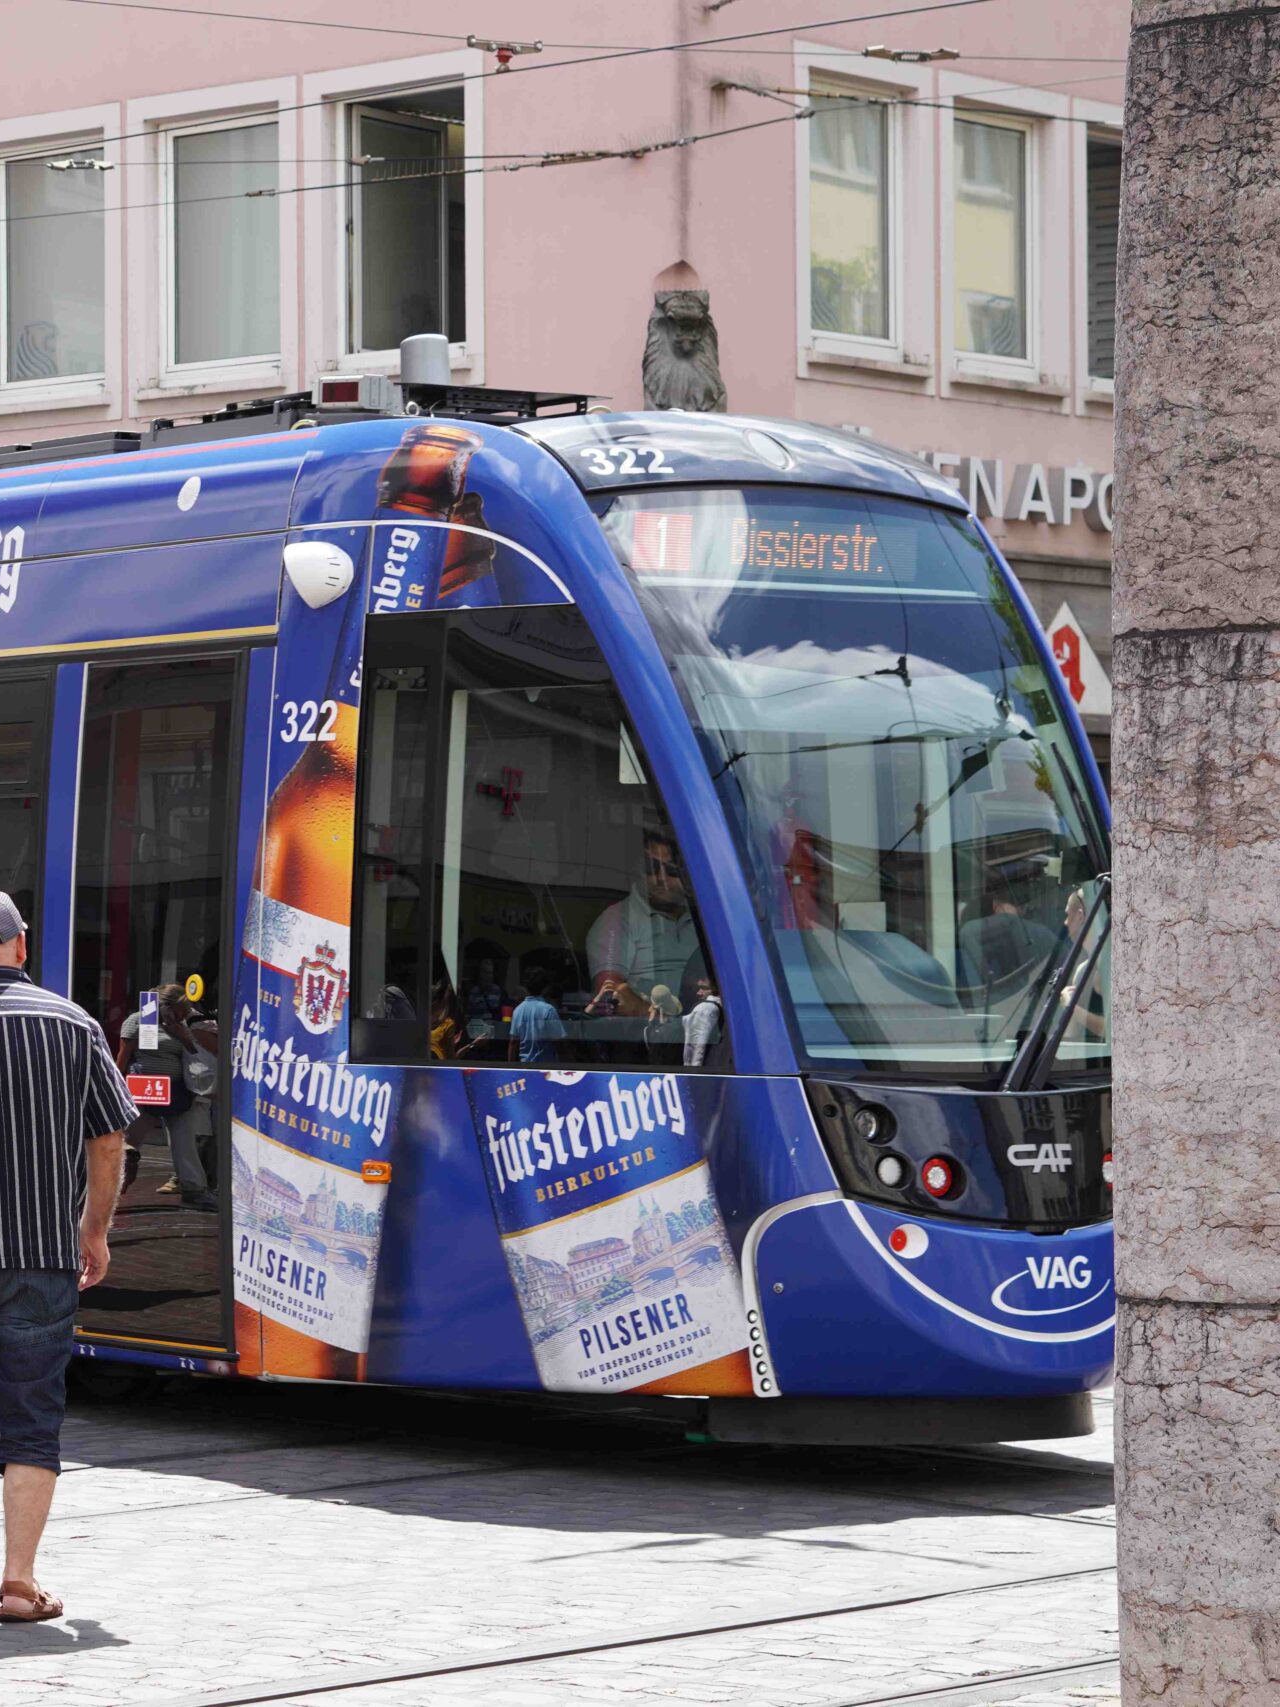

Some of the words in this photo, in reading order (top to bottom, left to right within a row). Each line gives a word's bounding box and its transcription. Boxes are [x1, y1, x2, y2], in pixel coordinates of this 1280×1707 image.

[580, 446, 674, 476] 322
[657, 516, 668, 567] 1
[729, 517, 883, 573] Bissierstr.
[280, 699, 338, 743] 322
[497, 1078, 526, 1099] SEIT
[254, 1096, 352, 1149] BIERKULTUR
[536, 1146, 657, 1203] BIERKULTUR
[1007, 1143, 1072, 1173] CAF
[239, 1234, 327, 1301] PILSENER
[1025, 1255, 1092, 1289] VAG
[287, 1296, 304, 1309] DER
[578, 1293, 694, 1359] PILSENER
[577, 1367, 597, 1379] VOM
[599, 1348, 653, 1372] URSPRUNG
[656, 1339, 676, 1353] DER
[679, 1326, 712, 1344] DONAU
[601, 1346, 694, 1385] DONAUESCHINGEN
